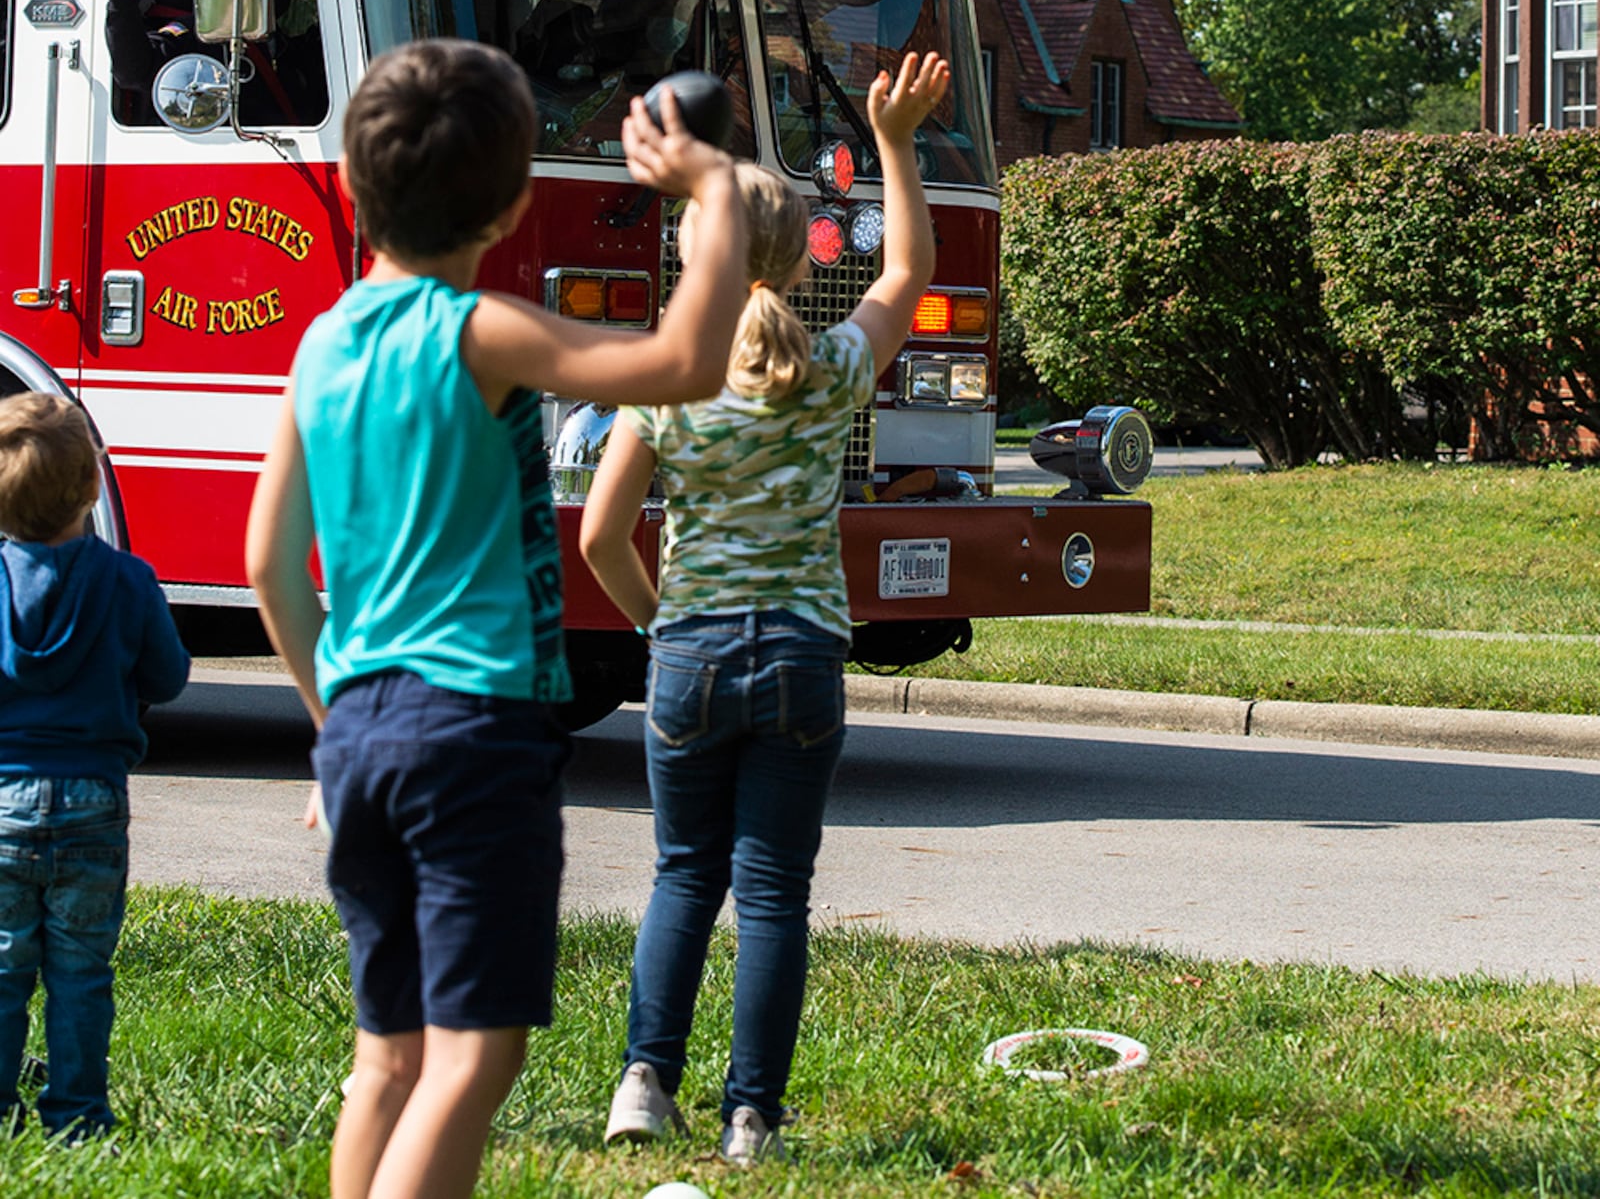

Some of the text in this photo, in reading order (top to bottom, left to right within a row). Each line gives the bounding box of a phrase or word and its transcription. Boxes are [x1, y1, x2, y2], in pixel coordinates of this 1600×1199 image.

[125, 196, 314, 261] UNITED STATES
[151, 286, 285, 334] AIR FORCE
